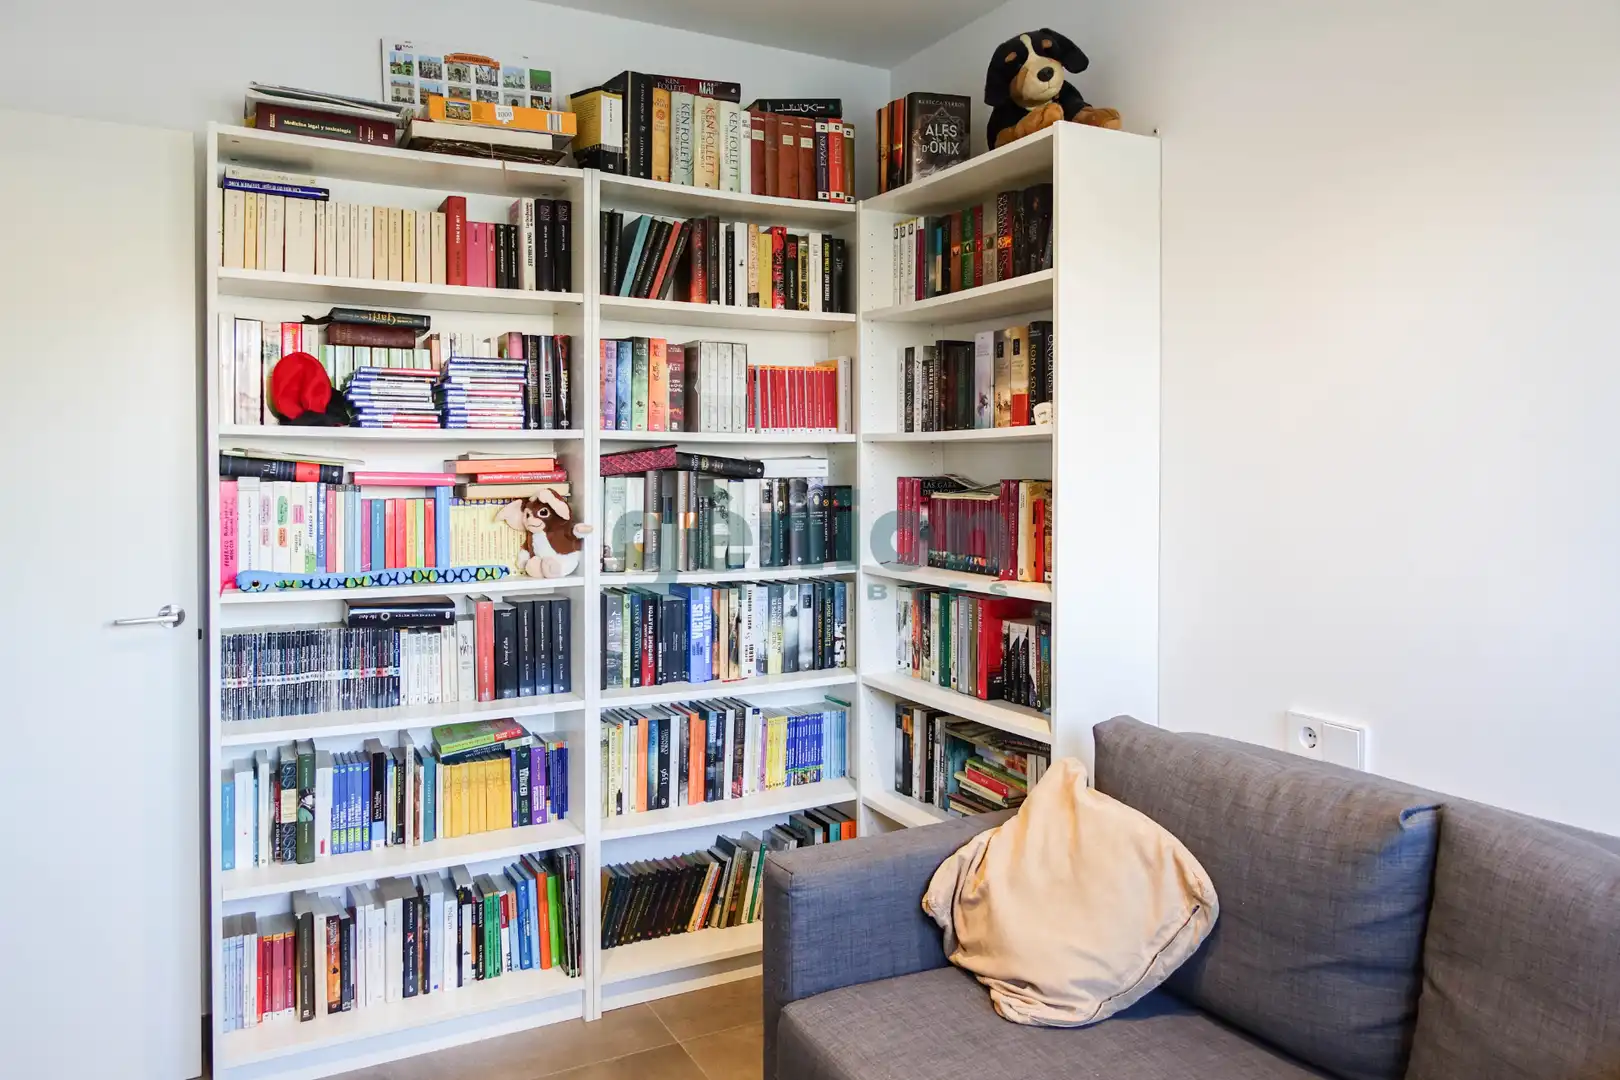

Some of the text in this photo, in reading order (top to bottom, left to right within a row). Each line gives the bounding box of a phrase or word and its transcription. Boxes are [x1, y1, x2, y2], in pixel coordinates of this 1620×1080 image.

[283, 119, 307, 128] Medicina
[680, 103, 690, 172] KEN FOLLETT
[925, 123, 958, 138] ALES
[705, 107, 715, 175] KEN FOLLETT
[729, 111, 738, 179] KEN FOLLETT
[819, 135, 827, 166] ERAGON
[692, 603, 703, 639] VICTUS
[703, 614, 711, 631] VAE
[519, 767, 529, 797] WICKED
[660, 768, 669, 785] 1356
